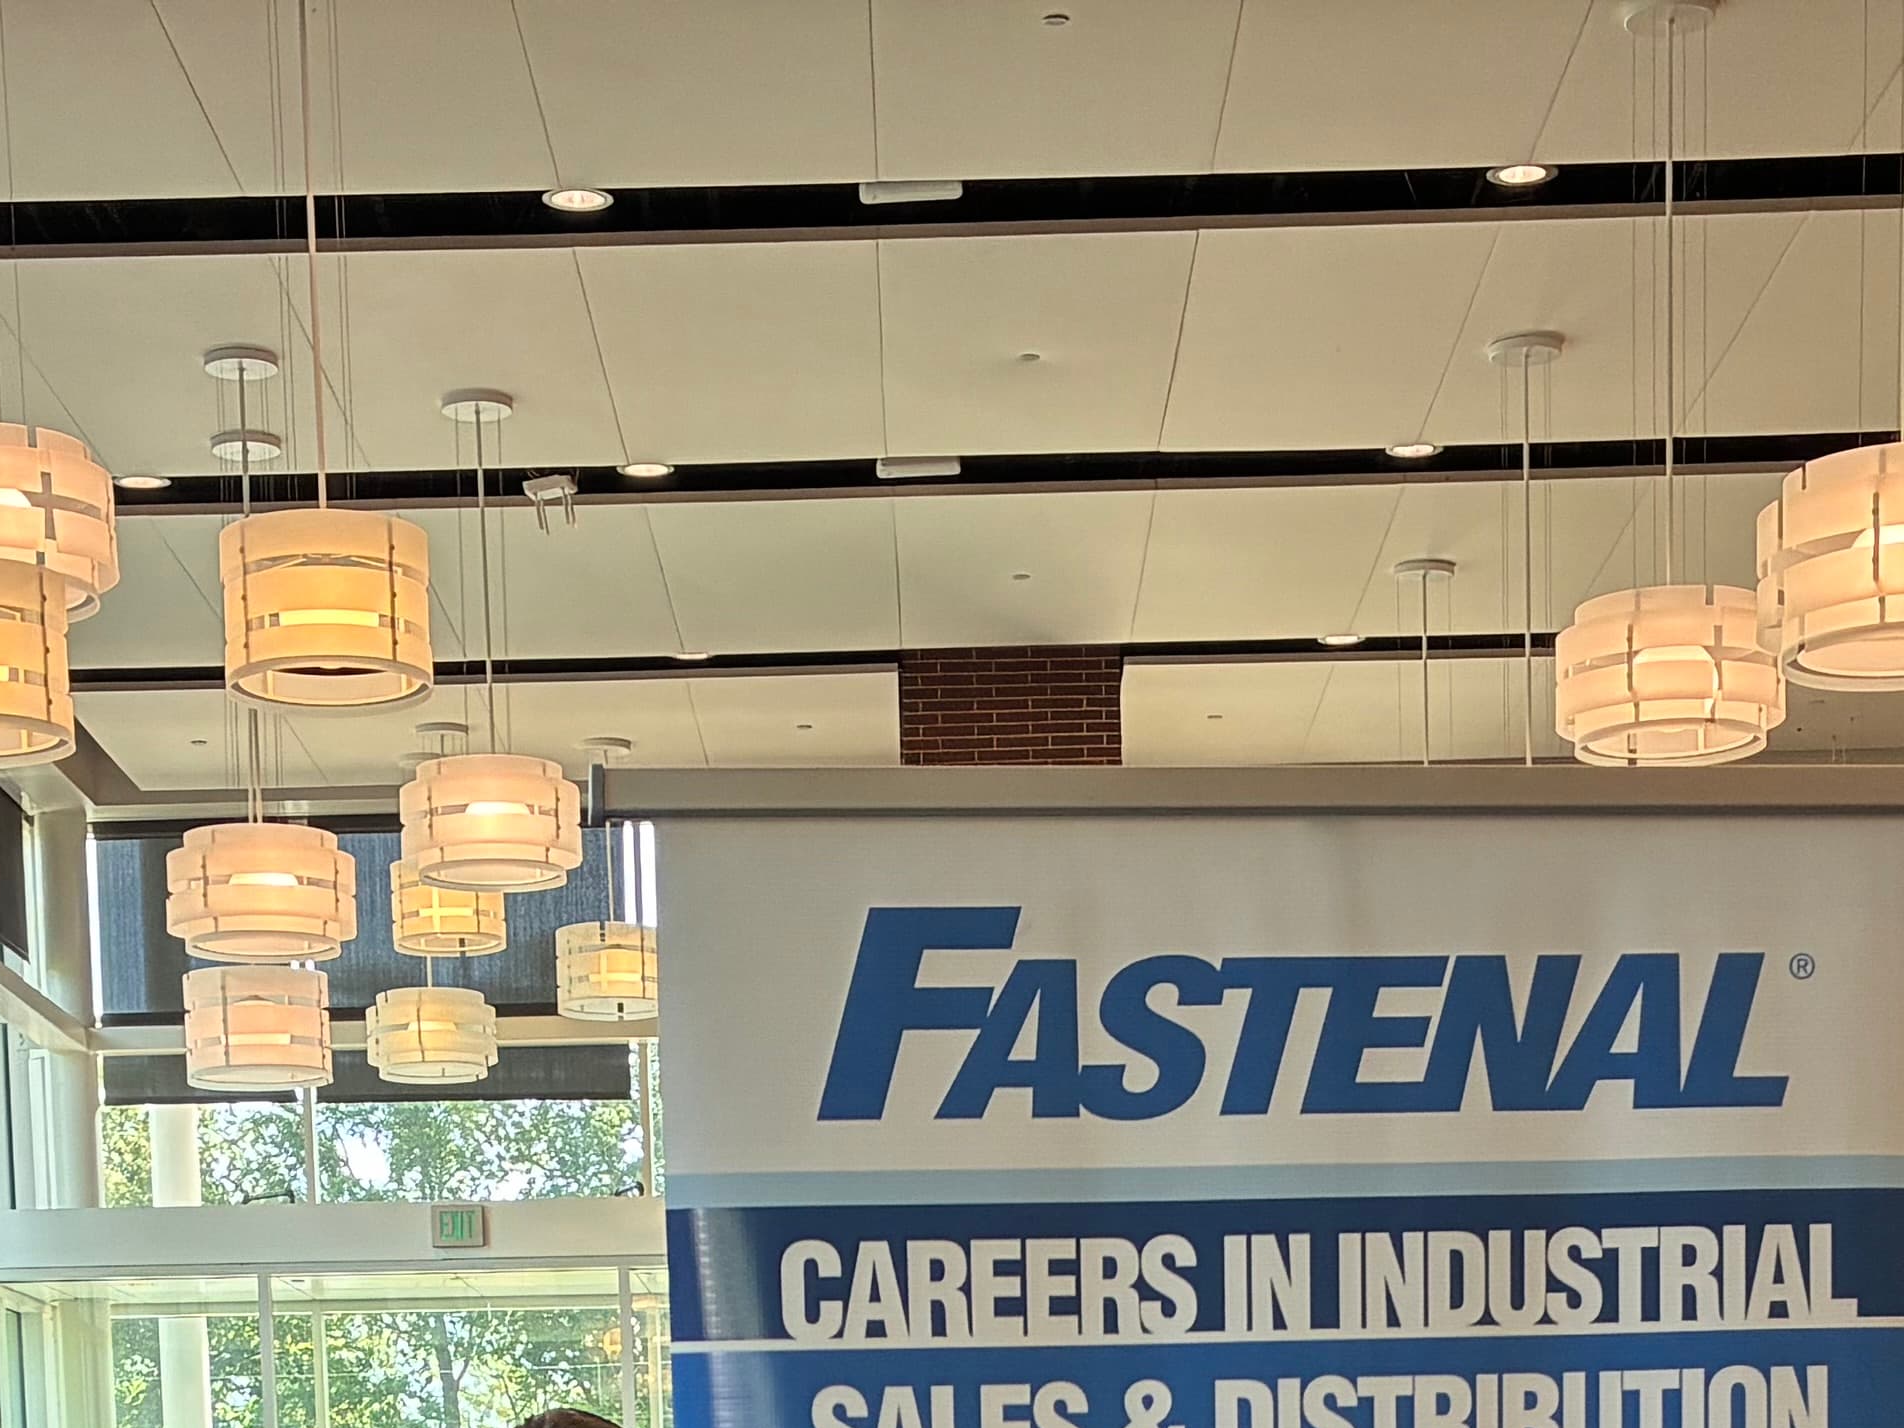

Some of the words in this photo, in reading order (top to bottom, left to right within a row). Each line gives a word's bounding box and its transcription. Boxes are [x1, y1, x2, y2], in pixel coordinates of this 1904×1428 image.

[816, 906, 1790, 1123] FASTENAL
[439, 1210, 476, 1241] EXIT
[779, 1233, 1196, 1342] CAREERS
[1222, 1232, 1313, 1334] IN
[1335, 1223, 1859, 1331] INDUSTRIAL
